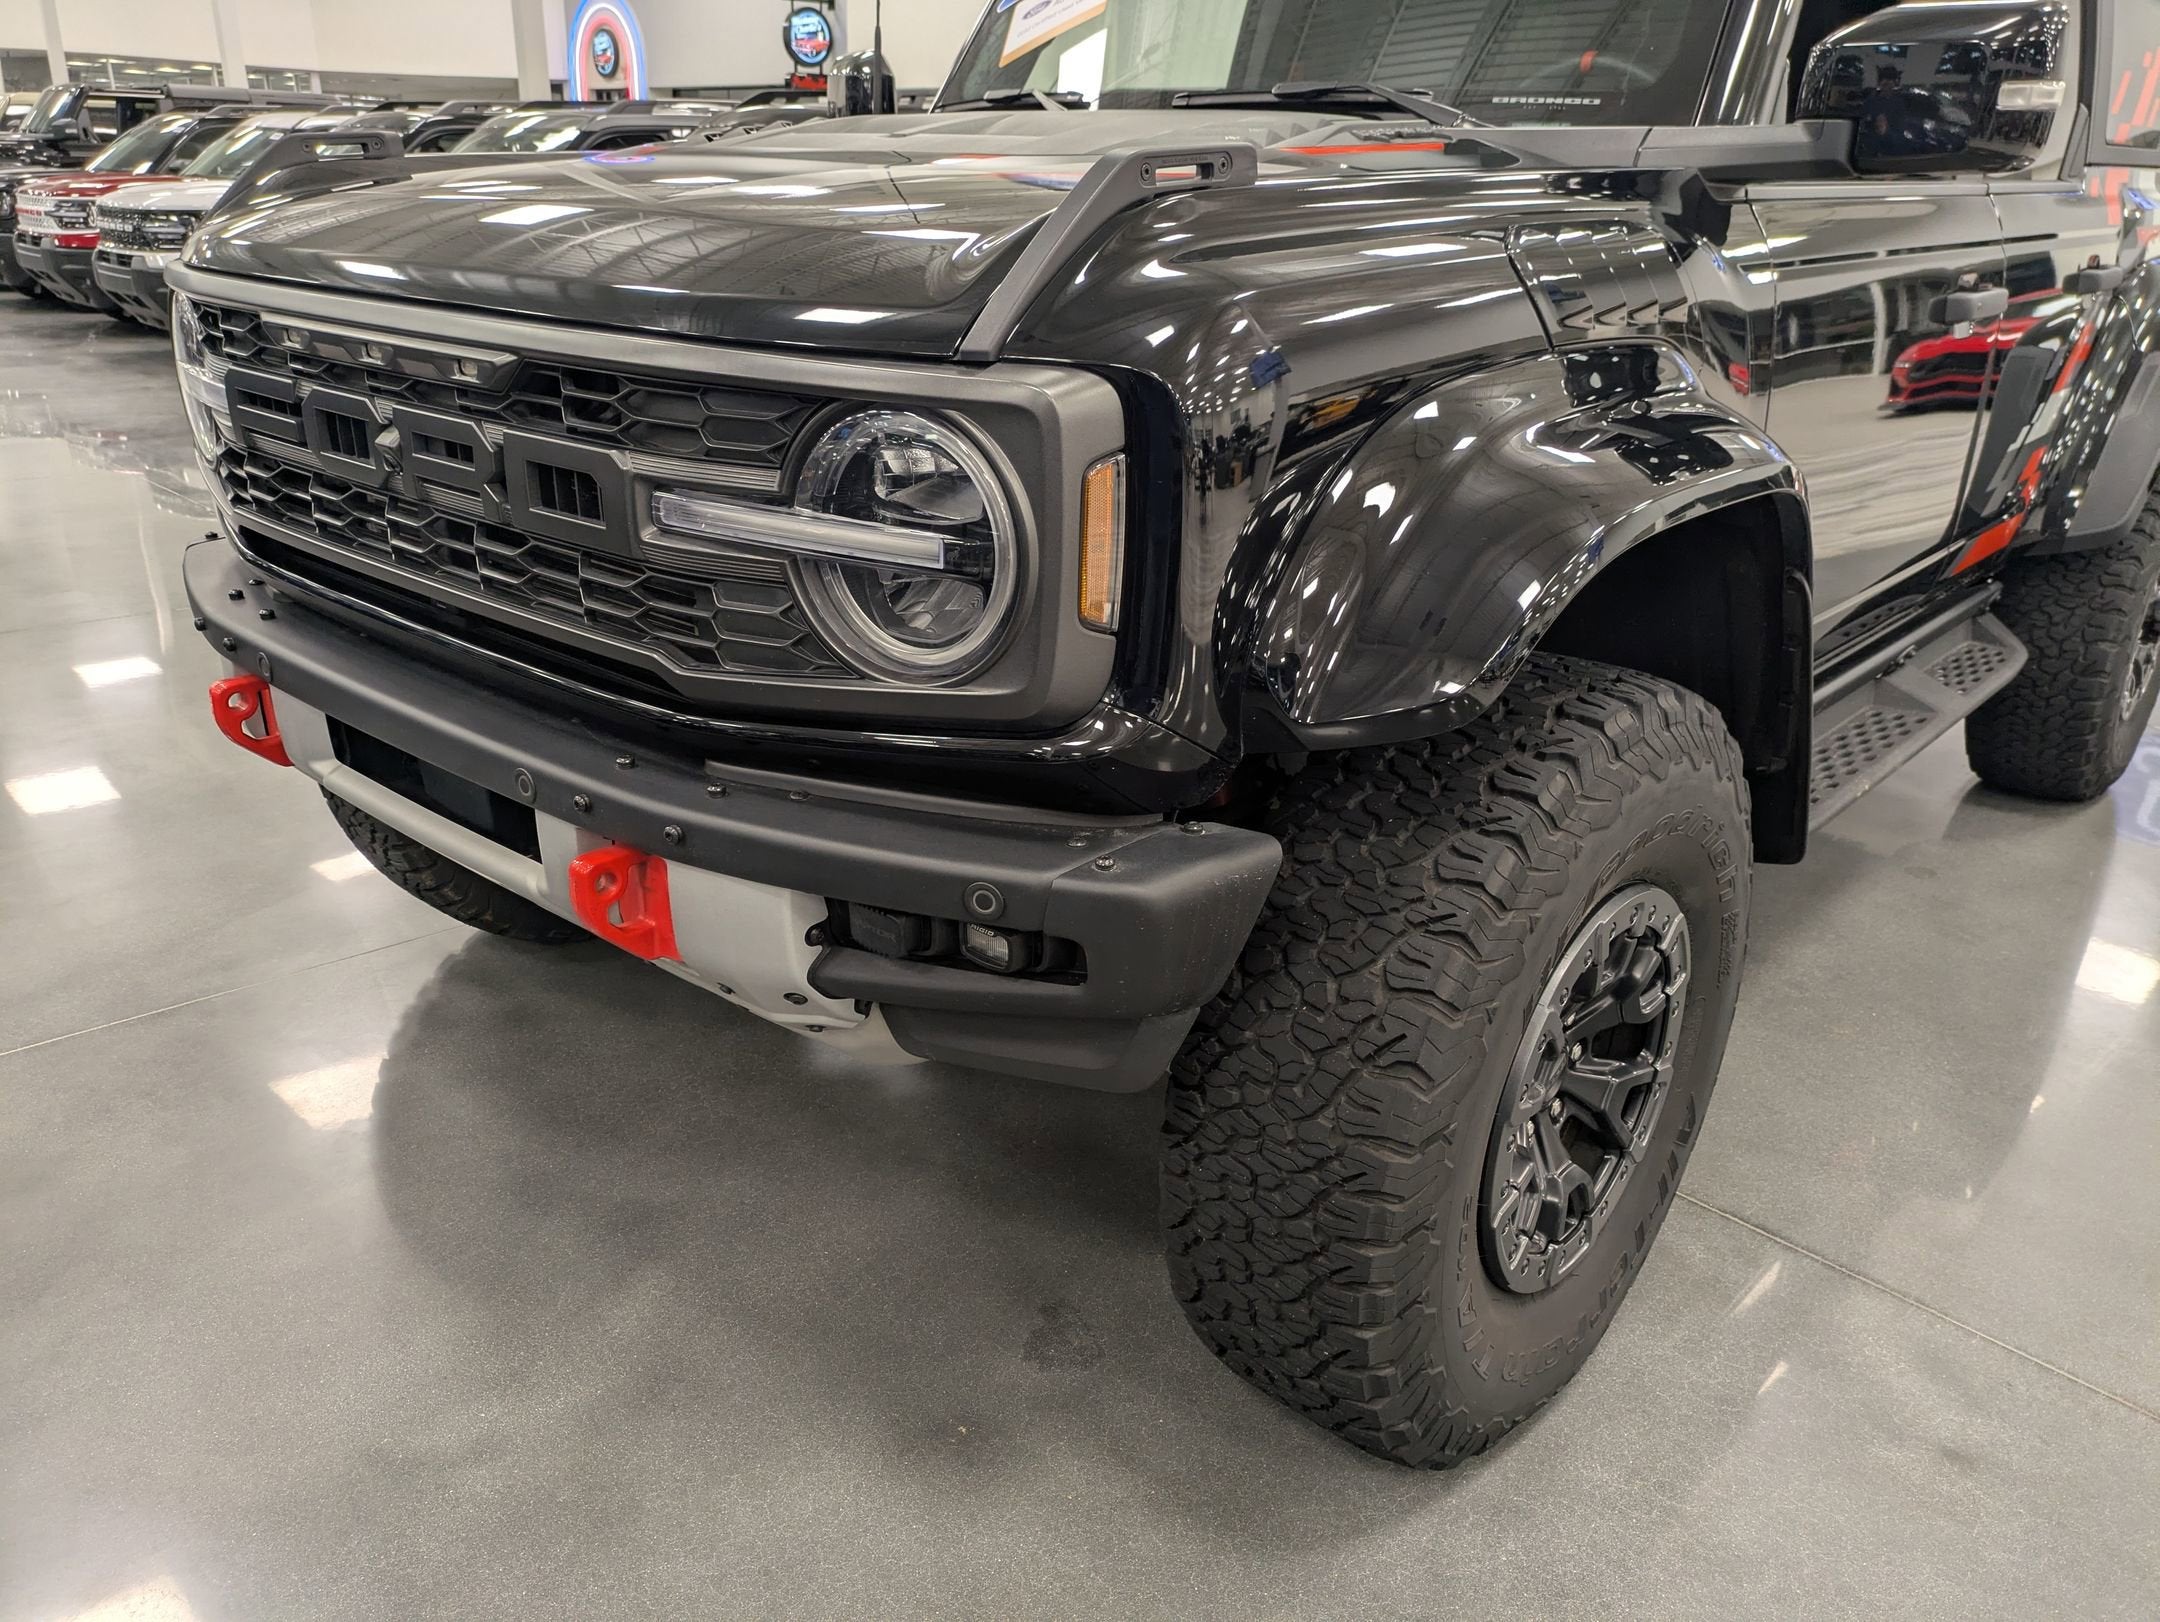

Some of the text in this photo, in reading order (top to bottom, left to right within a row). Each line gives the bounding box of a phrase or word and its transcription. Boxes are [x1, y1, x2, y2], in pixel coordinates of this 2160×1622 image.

[1492, 96, 1601, 105] BRONCO
[224, 364, 644, 560] FORD
[970, 923, 995, 937] RIGID
